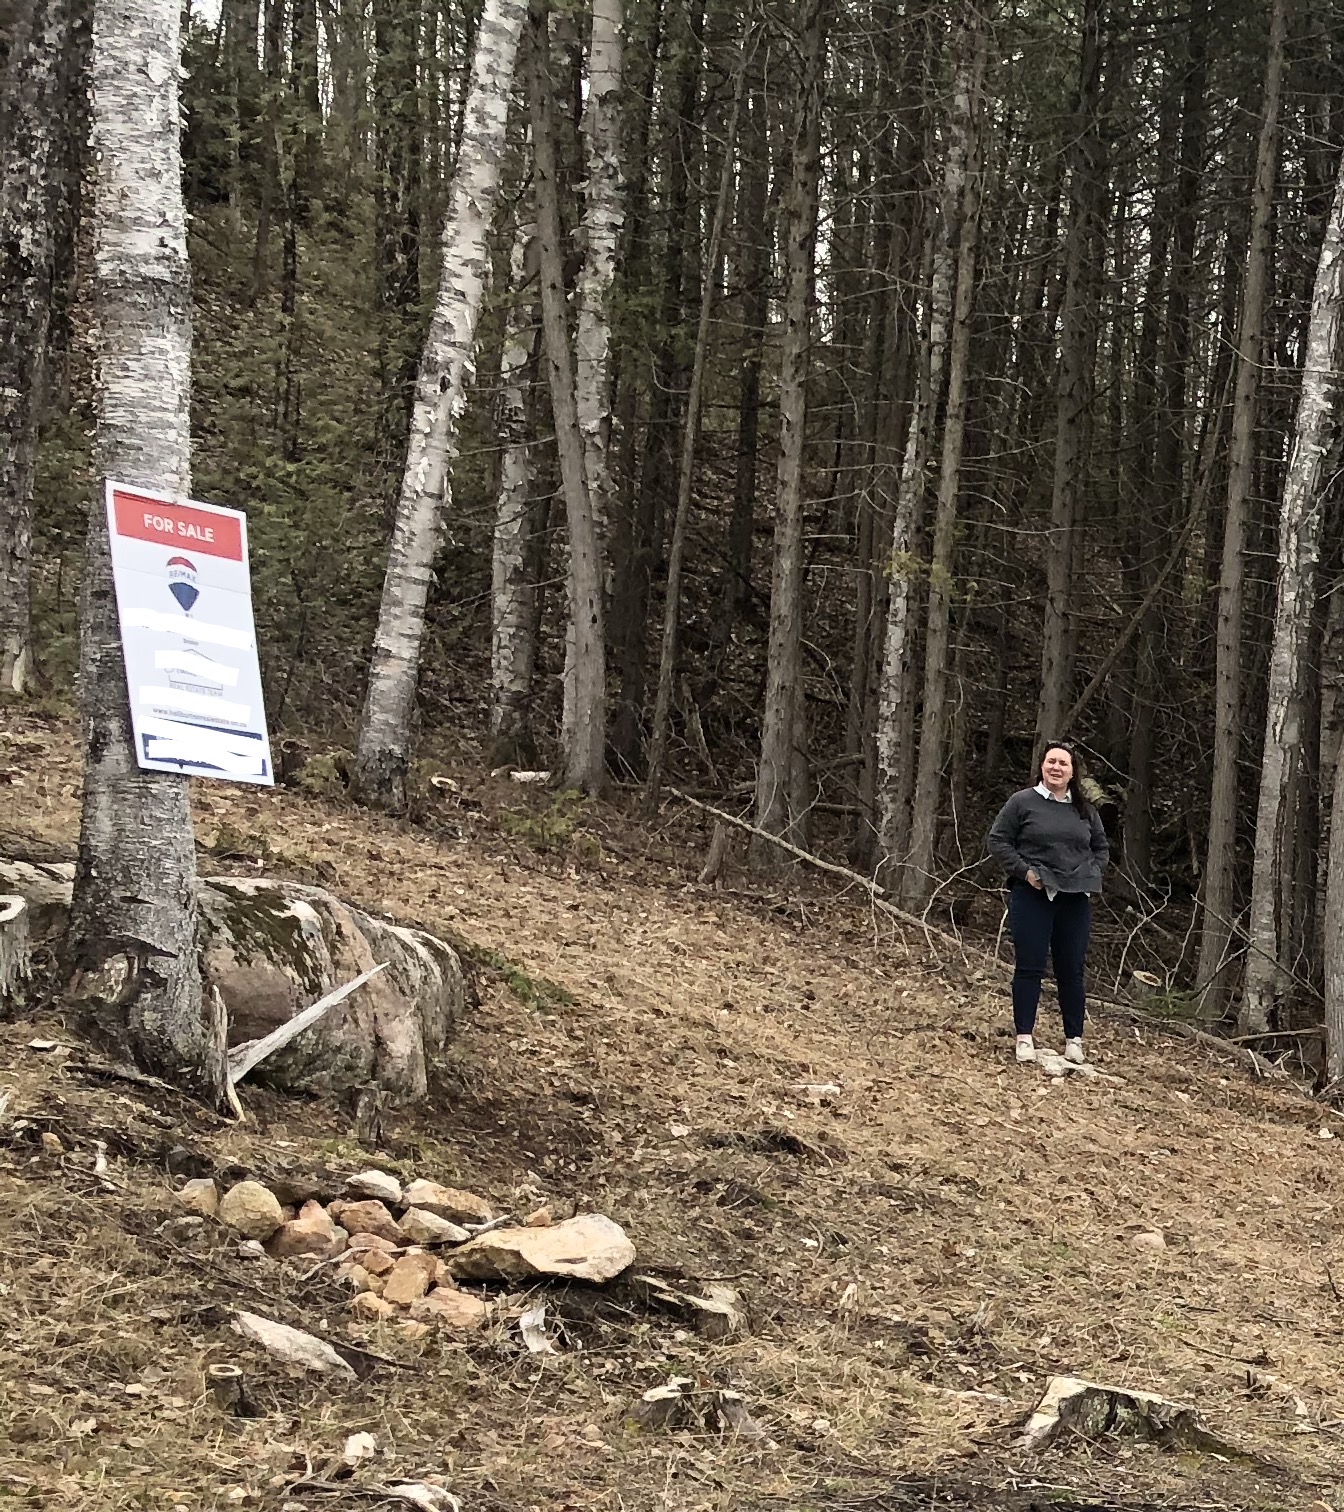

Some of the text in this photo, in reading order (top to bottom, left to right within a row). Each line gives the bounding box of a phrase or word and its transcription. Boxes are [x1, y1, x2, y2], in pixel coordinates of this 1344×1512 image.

[144, 513, 215, 543] FOR SALE
[168, 570, 197, 583] RE/MAX
